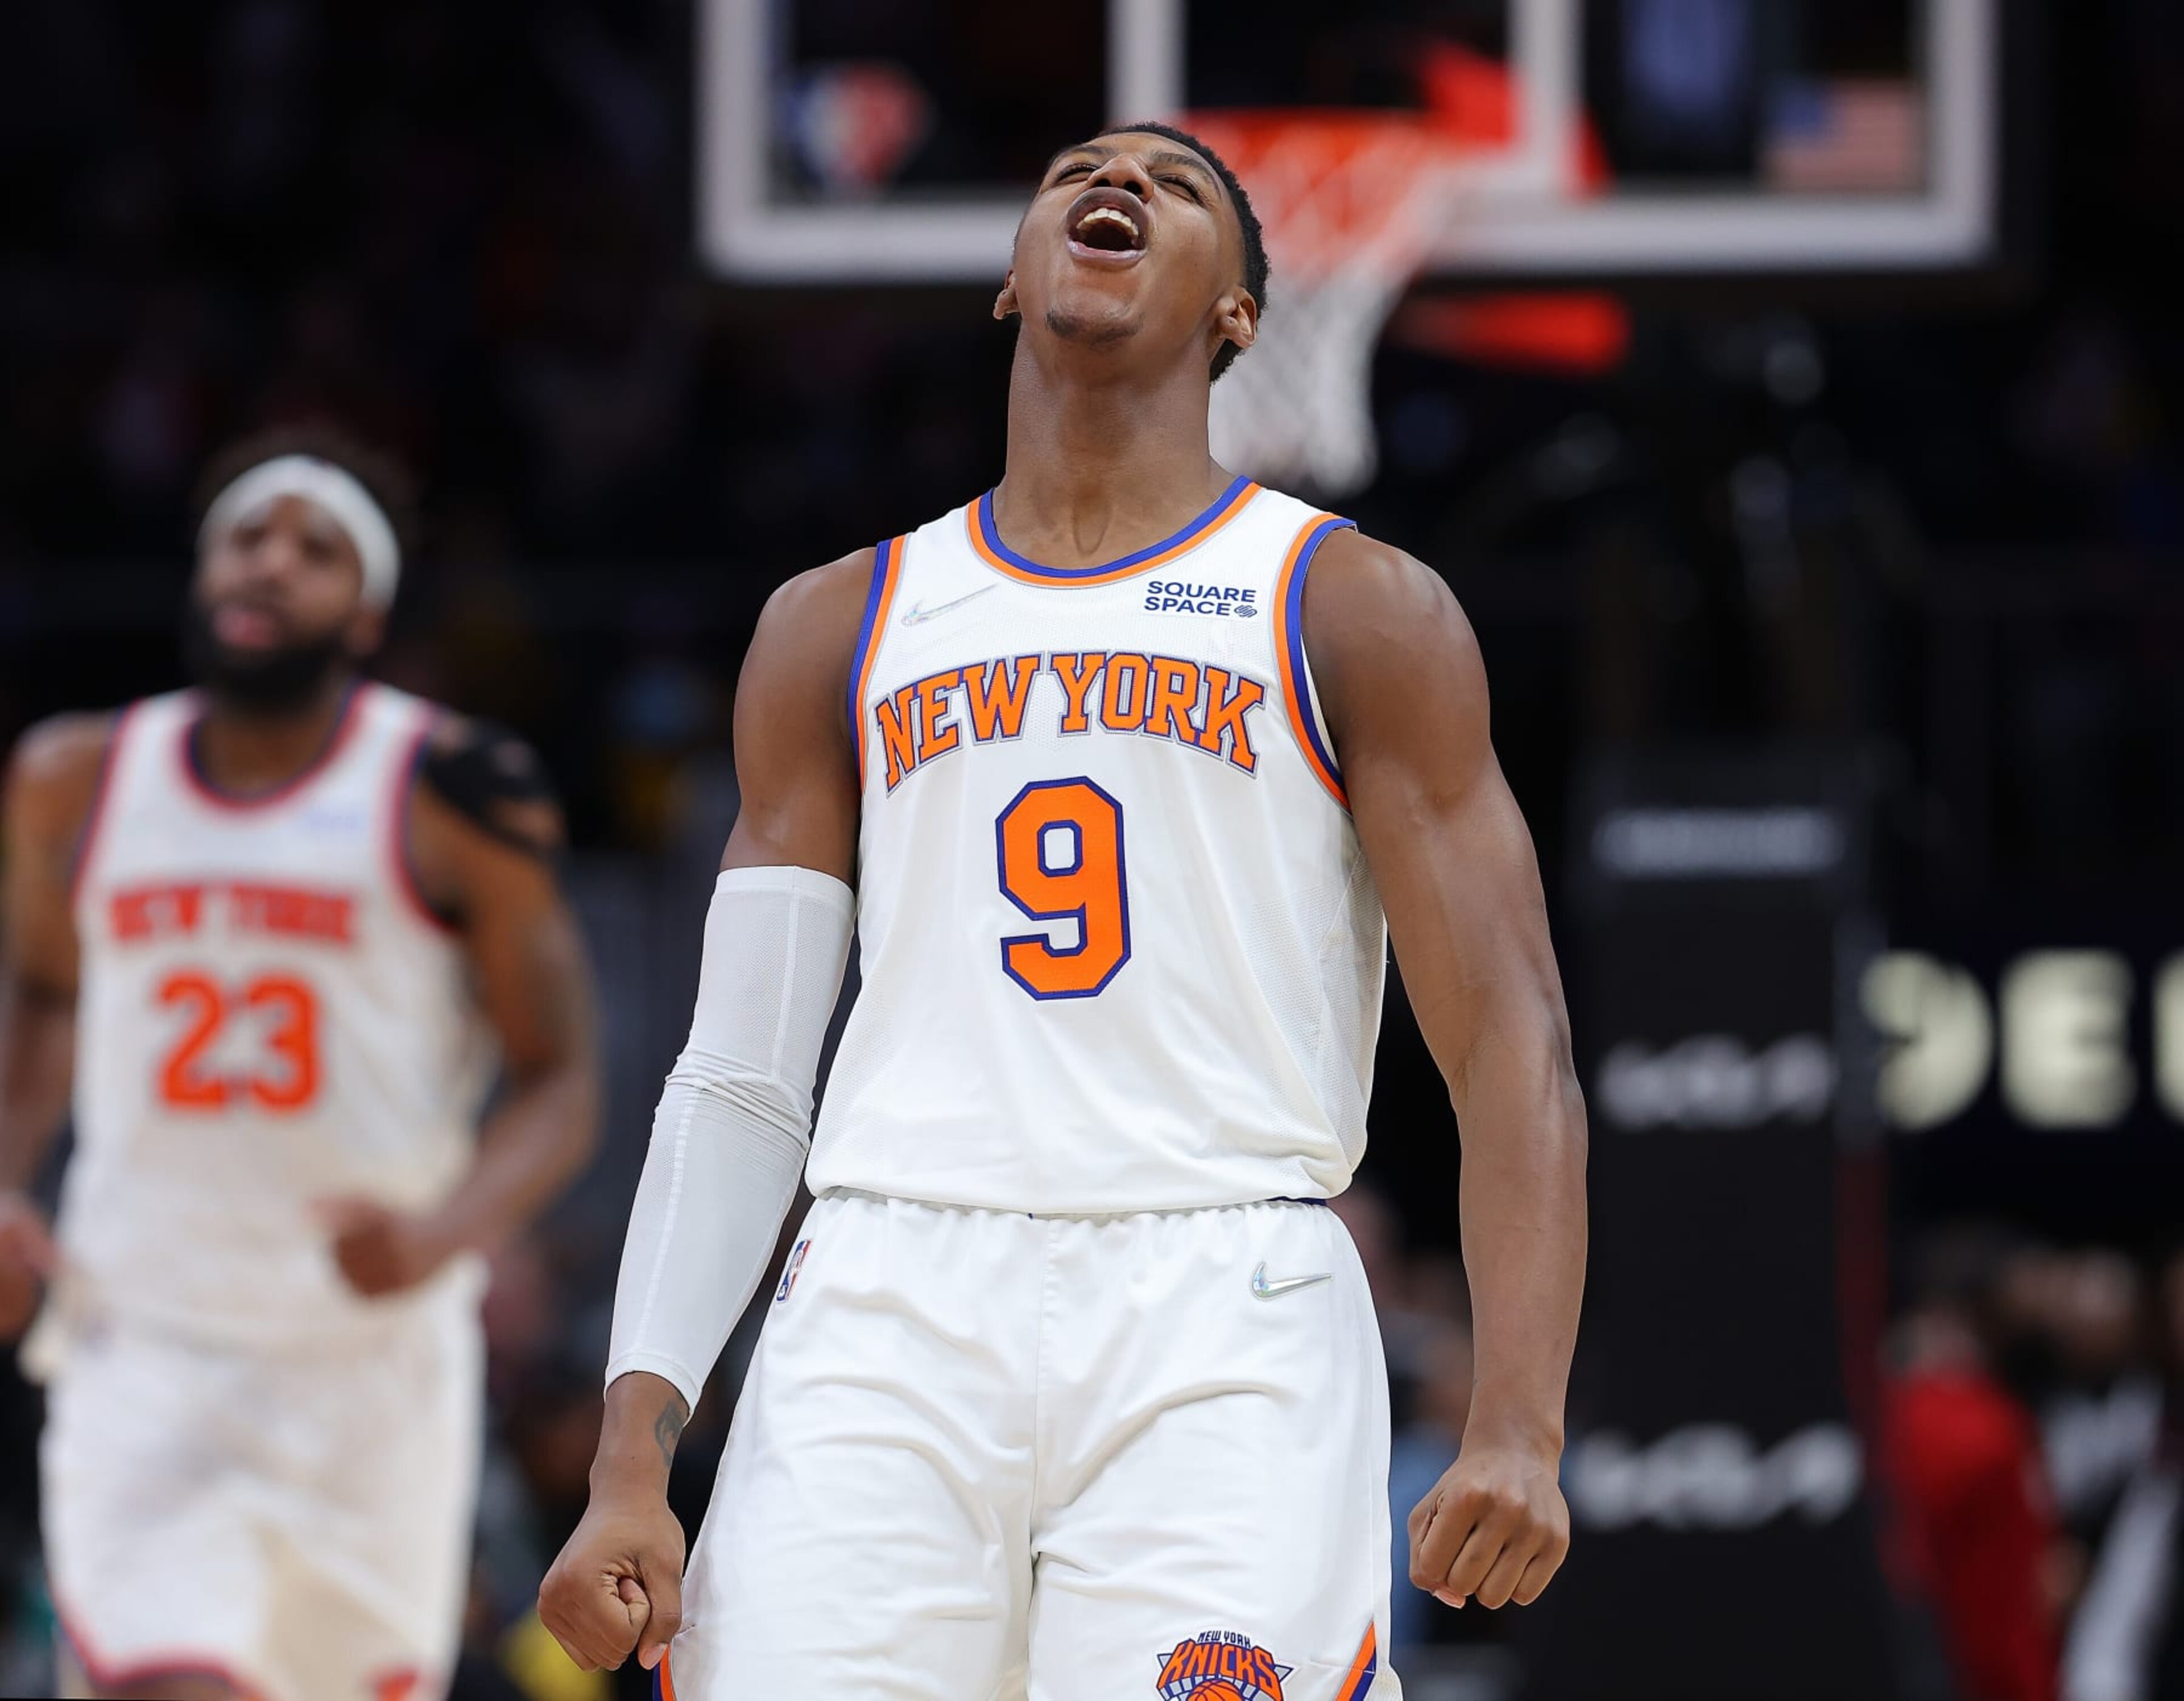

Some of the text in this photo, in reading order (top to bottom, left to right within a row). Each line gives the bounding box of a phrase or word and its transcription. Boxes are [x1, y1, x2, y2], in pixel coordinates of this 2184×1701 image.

[1144, 597, 1231, 616] SPACE
[1147, 581, 1256, 603] SQUARE
[875, 650, 1266, 796] NEW YORK
[995, 776, 1131, 1001] 9
[156, 970, 324, 1113] 23
[1156, 1638, 1284, 1701] KNICKS
[1197, 1630, 1251, 1649] NEW YORK
